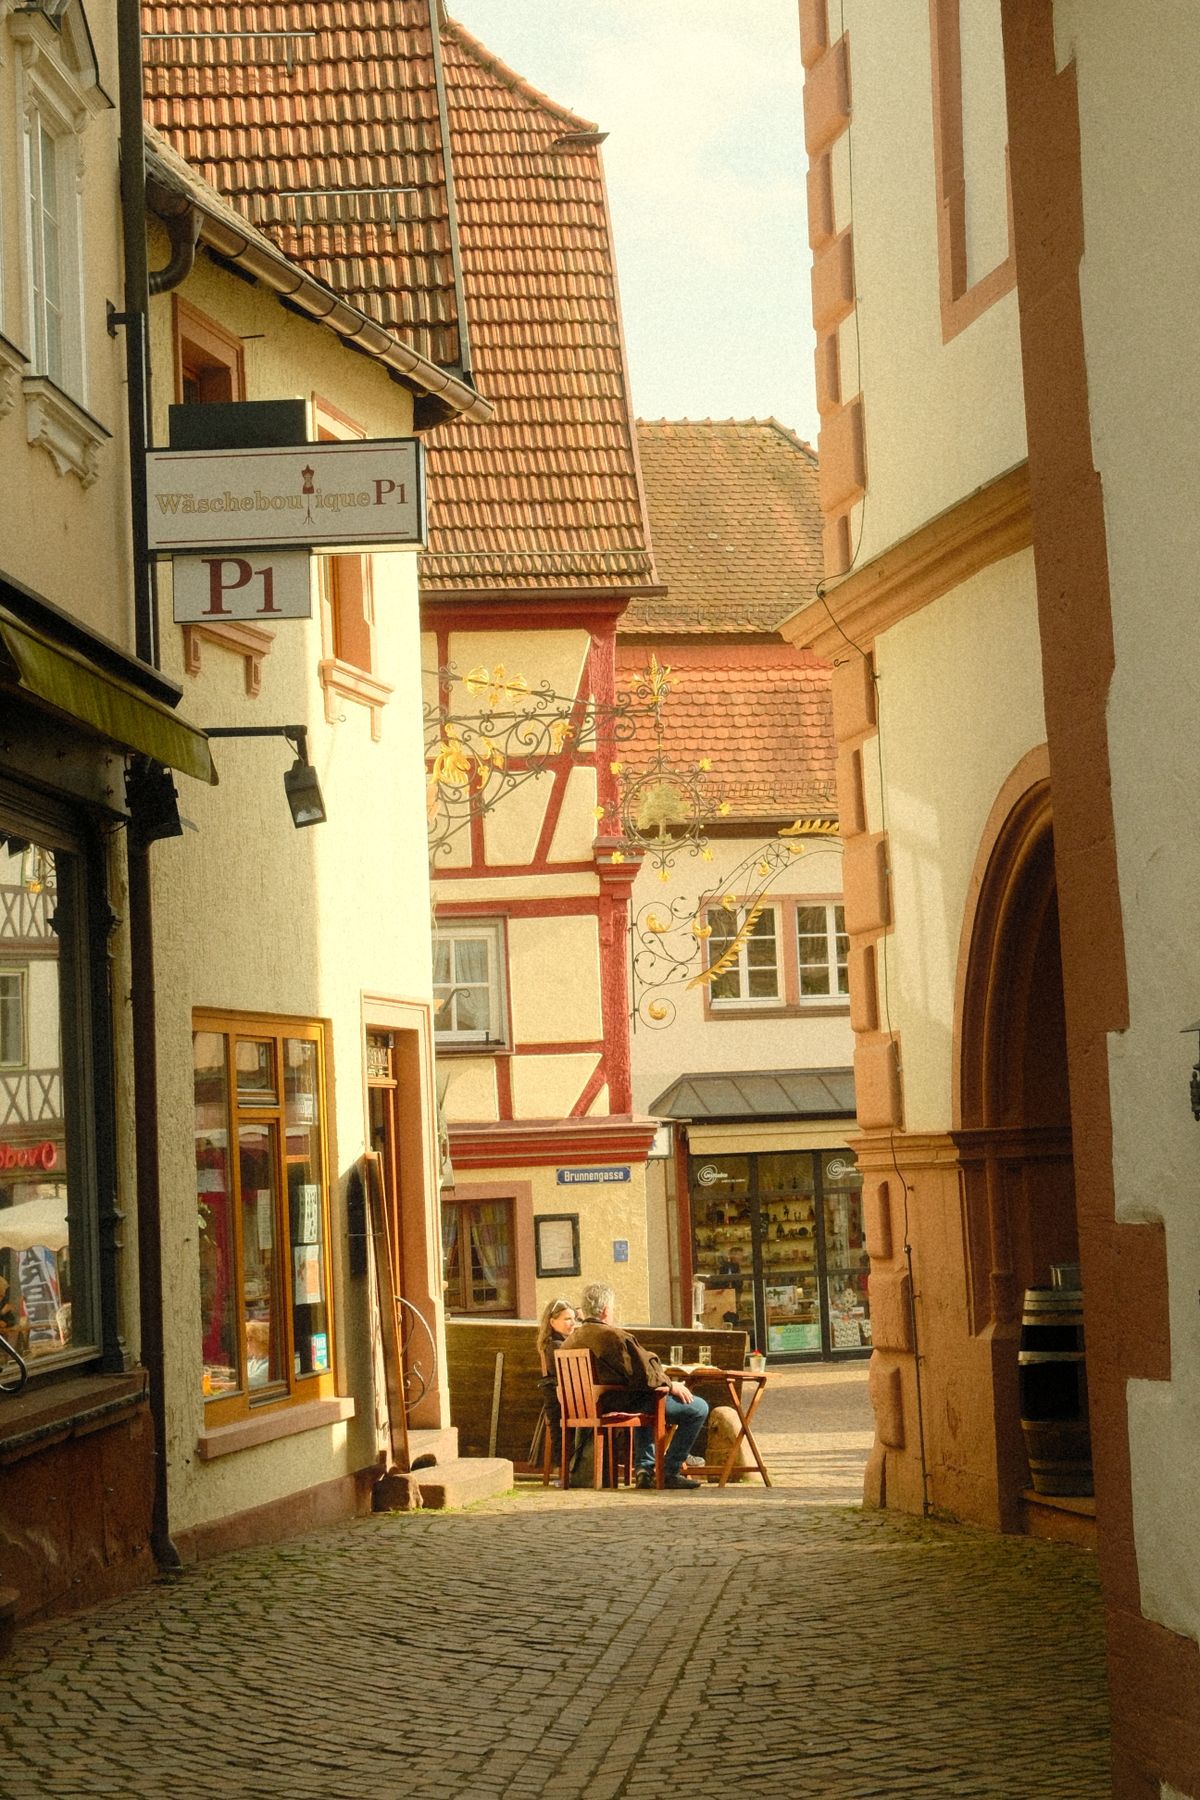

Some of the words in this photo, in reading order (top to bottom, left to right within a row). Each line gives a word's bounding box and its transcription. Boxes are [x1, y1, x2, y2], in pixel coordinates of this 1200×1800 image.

[371, 479, 409, 506] P1
[201, 558, 283, 615] P1
[564, 1170, 625, 1183] Brunnengasse
